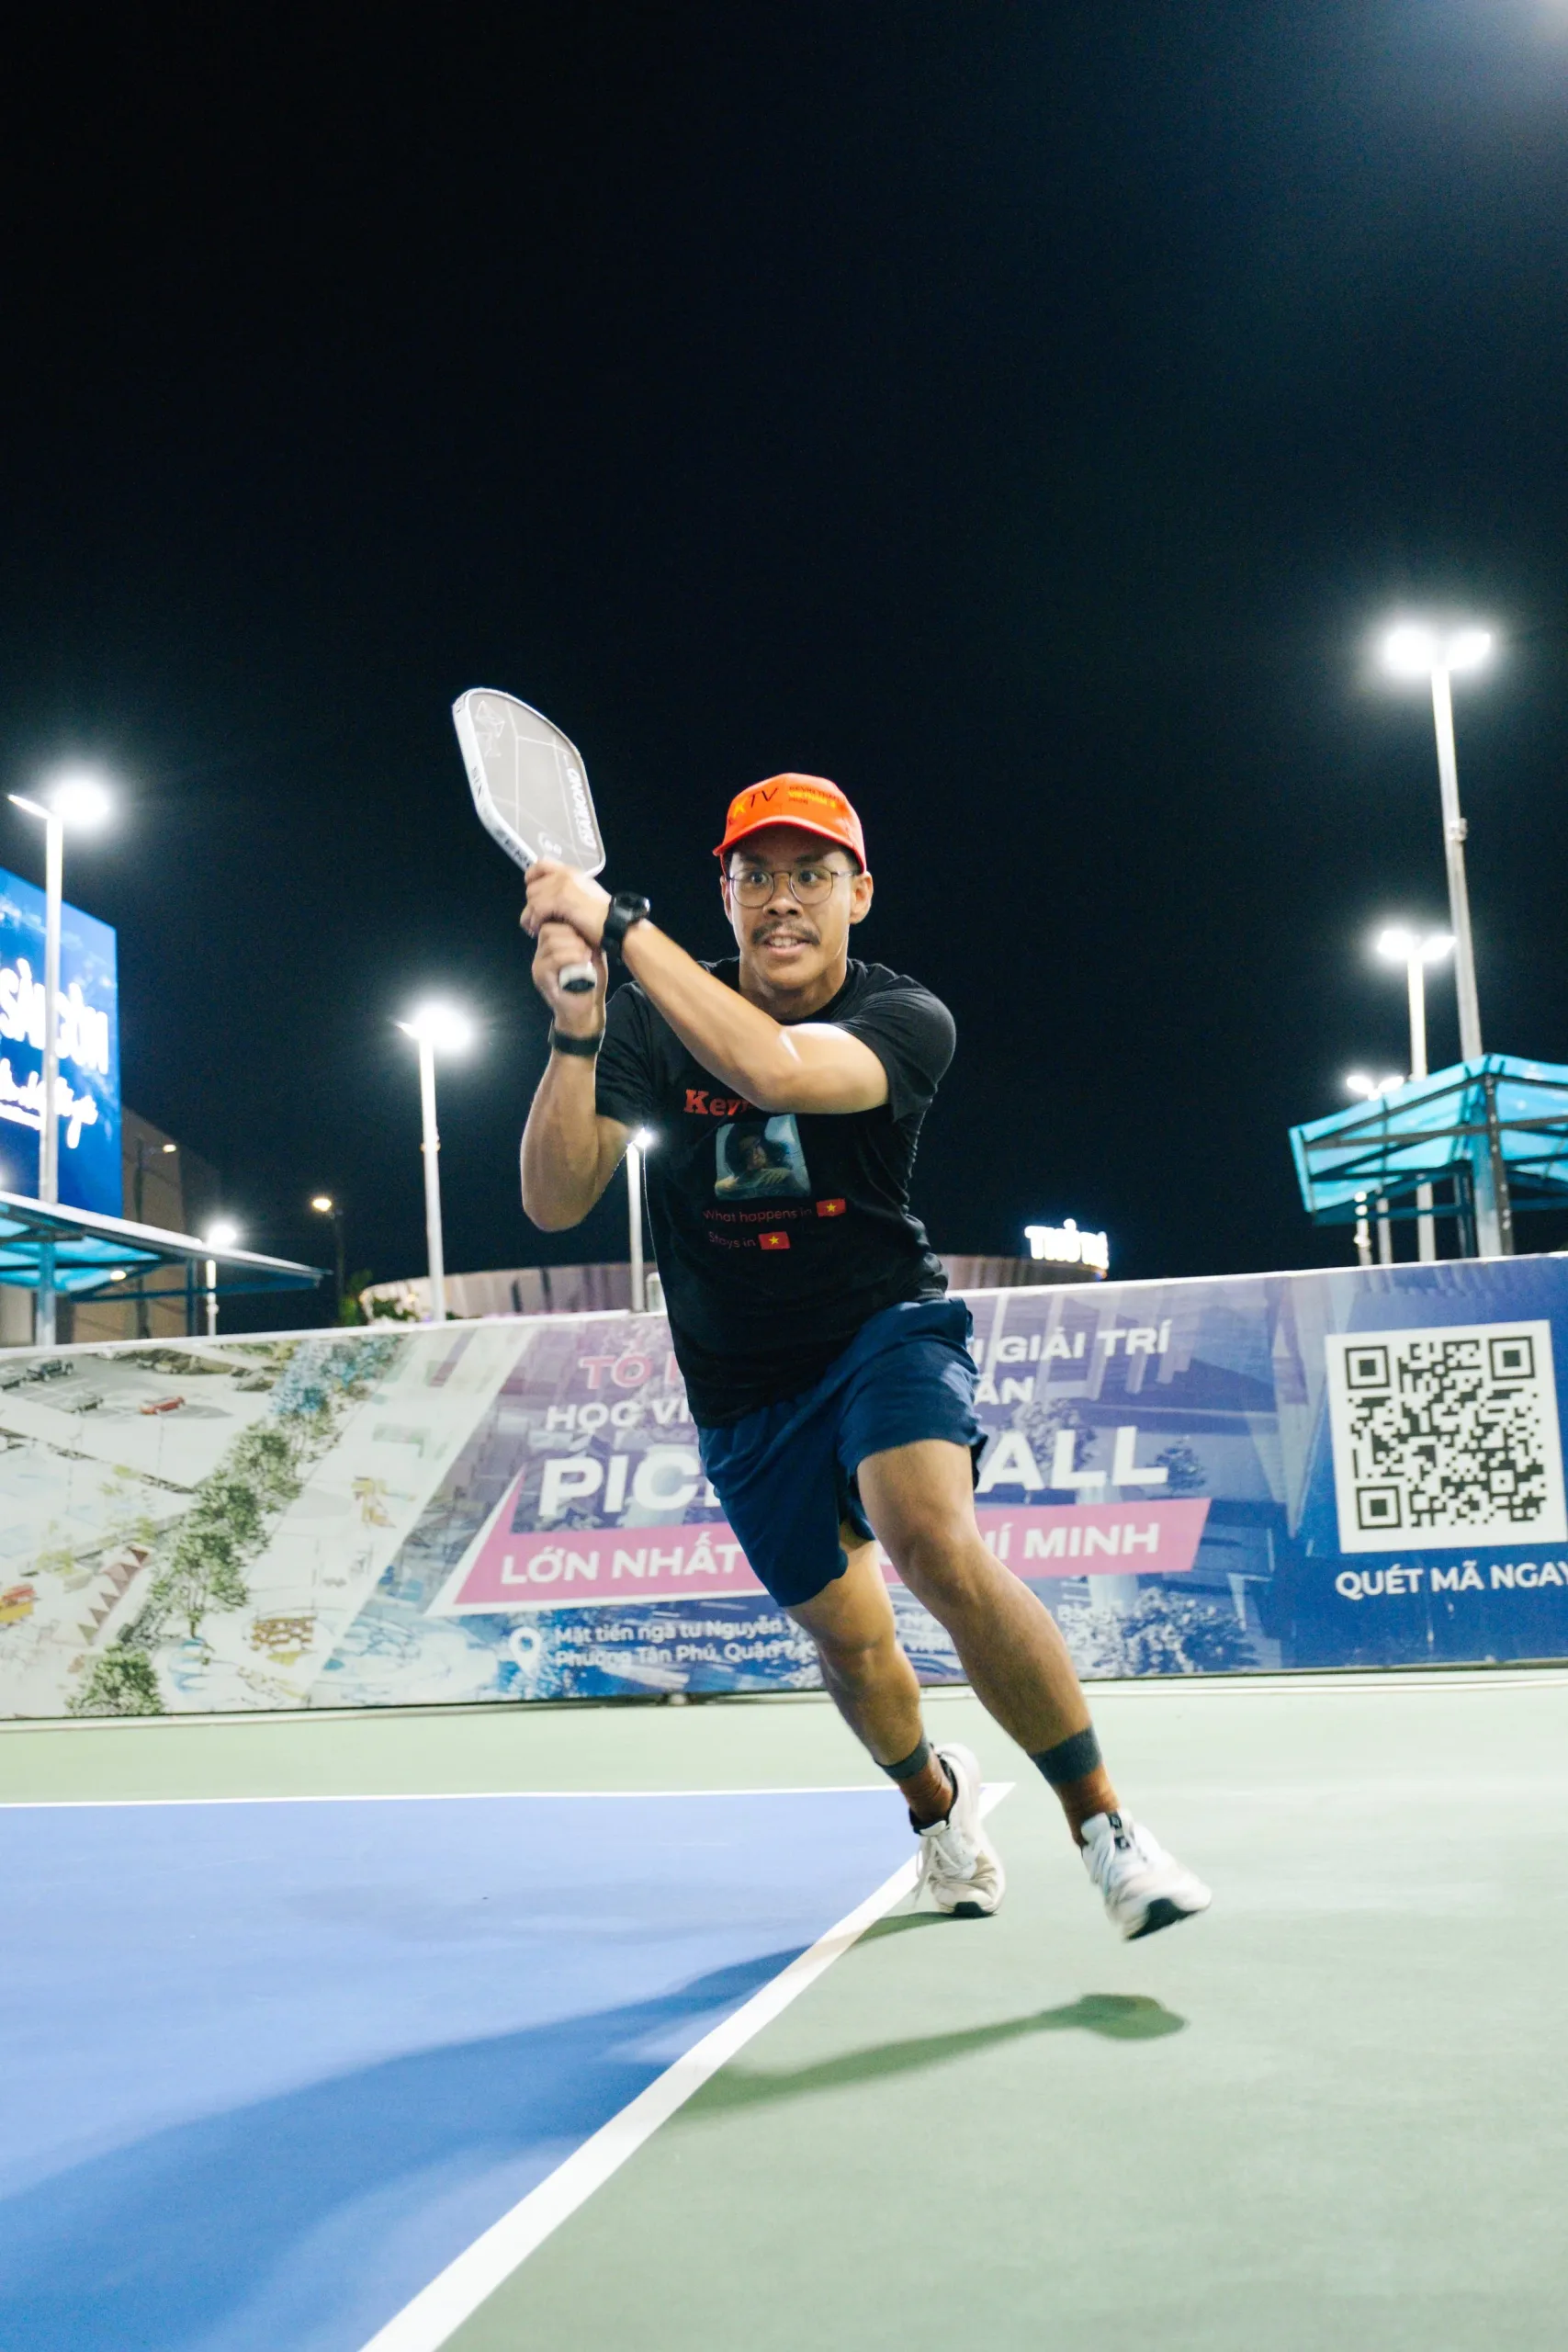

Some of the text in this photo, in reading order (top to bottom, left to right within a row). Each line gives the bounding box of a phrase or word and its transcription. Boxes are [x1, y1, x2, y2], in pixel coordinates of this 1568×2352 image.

[703, 1209, 736, 1223] What
[739, 1207, 797, 1223] happens
[742, 1237, 757, 1247] in
[1096, 1318, 1172, 1358] TRÍ
[546, 1399, 642, 1437] HỌC
[502, 1545, 600, 1586] LỚN
[611, 1532, 745, 1580] NHẤT
[1023, 1522, 1159, 1560] MINH
[1336, 1564, 1424, 1600] QUÉT
[1429, 1560, 1485, 1592] MÃ
